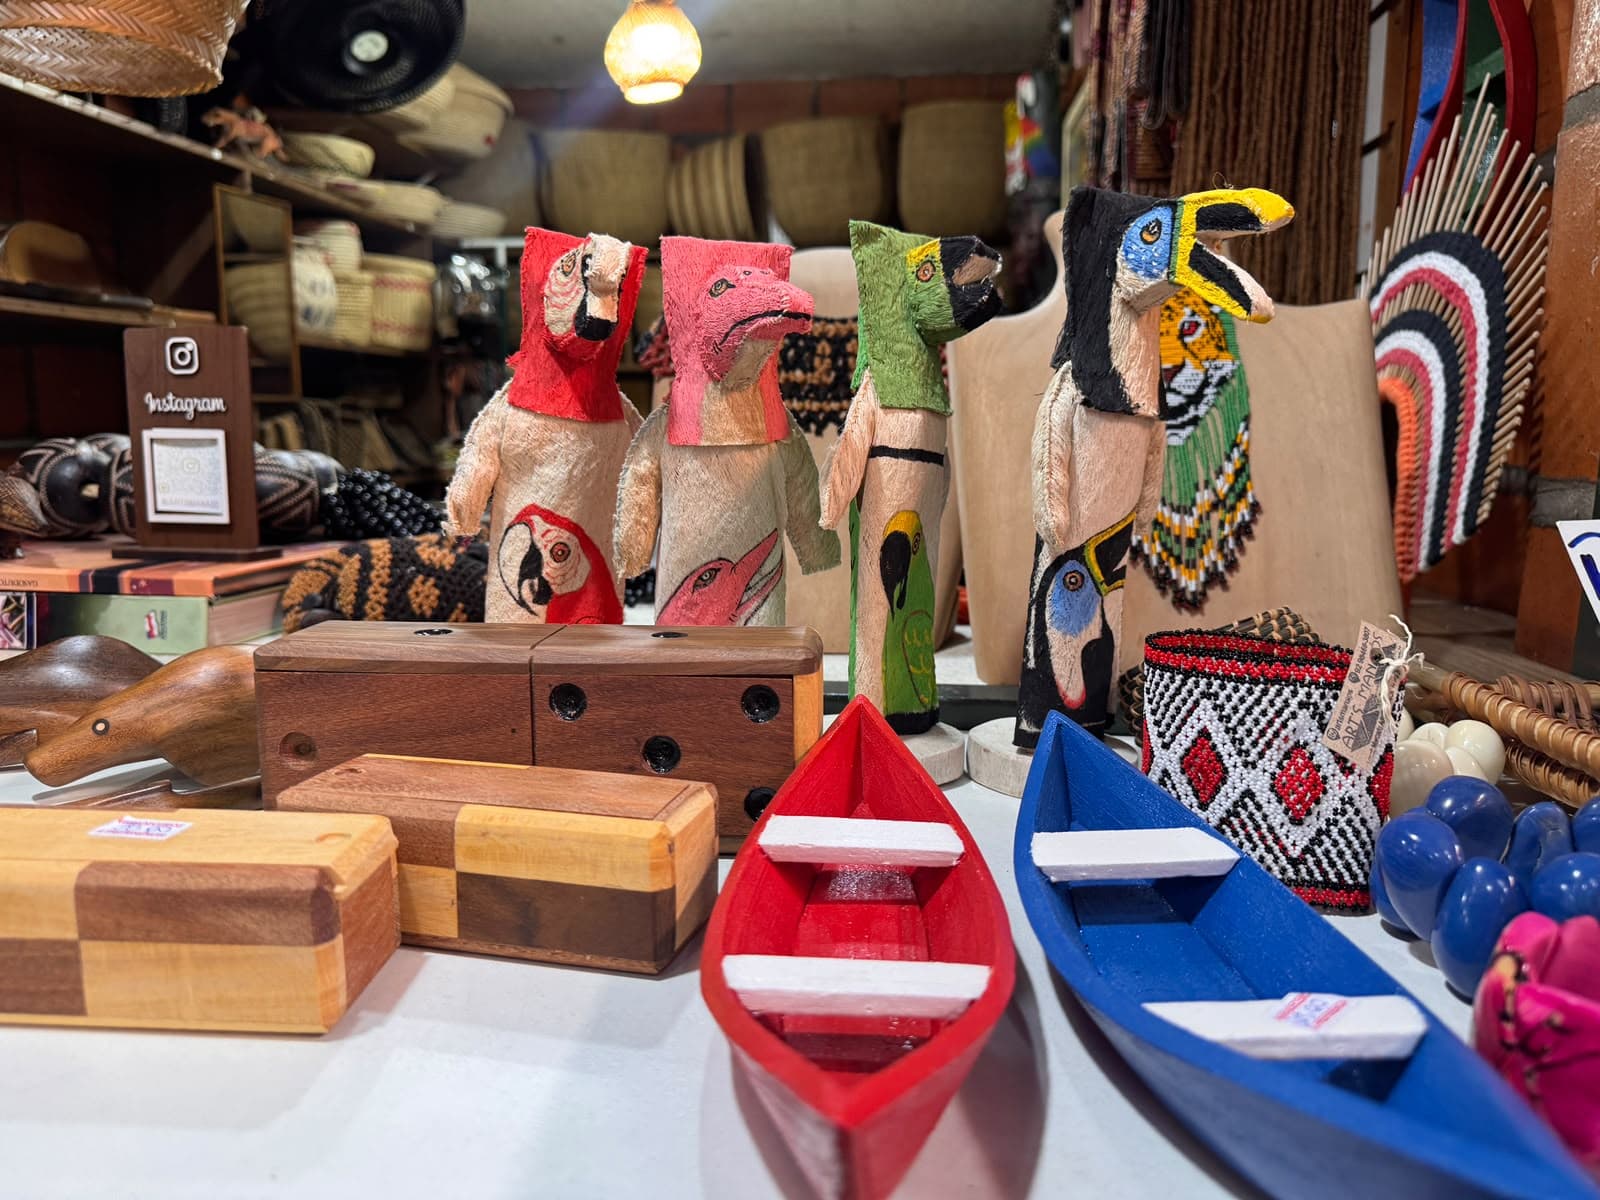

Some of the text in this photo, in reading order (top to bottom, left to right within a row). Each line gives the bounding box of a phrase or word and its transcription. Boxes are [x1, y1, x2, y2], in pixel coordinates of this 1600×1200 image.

[144, 391, 227, 420] Instagram
[1342, 631, 1383, 749] ART'S MANOS
